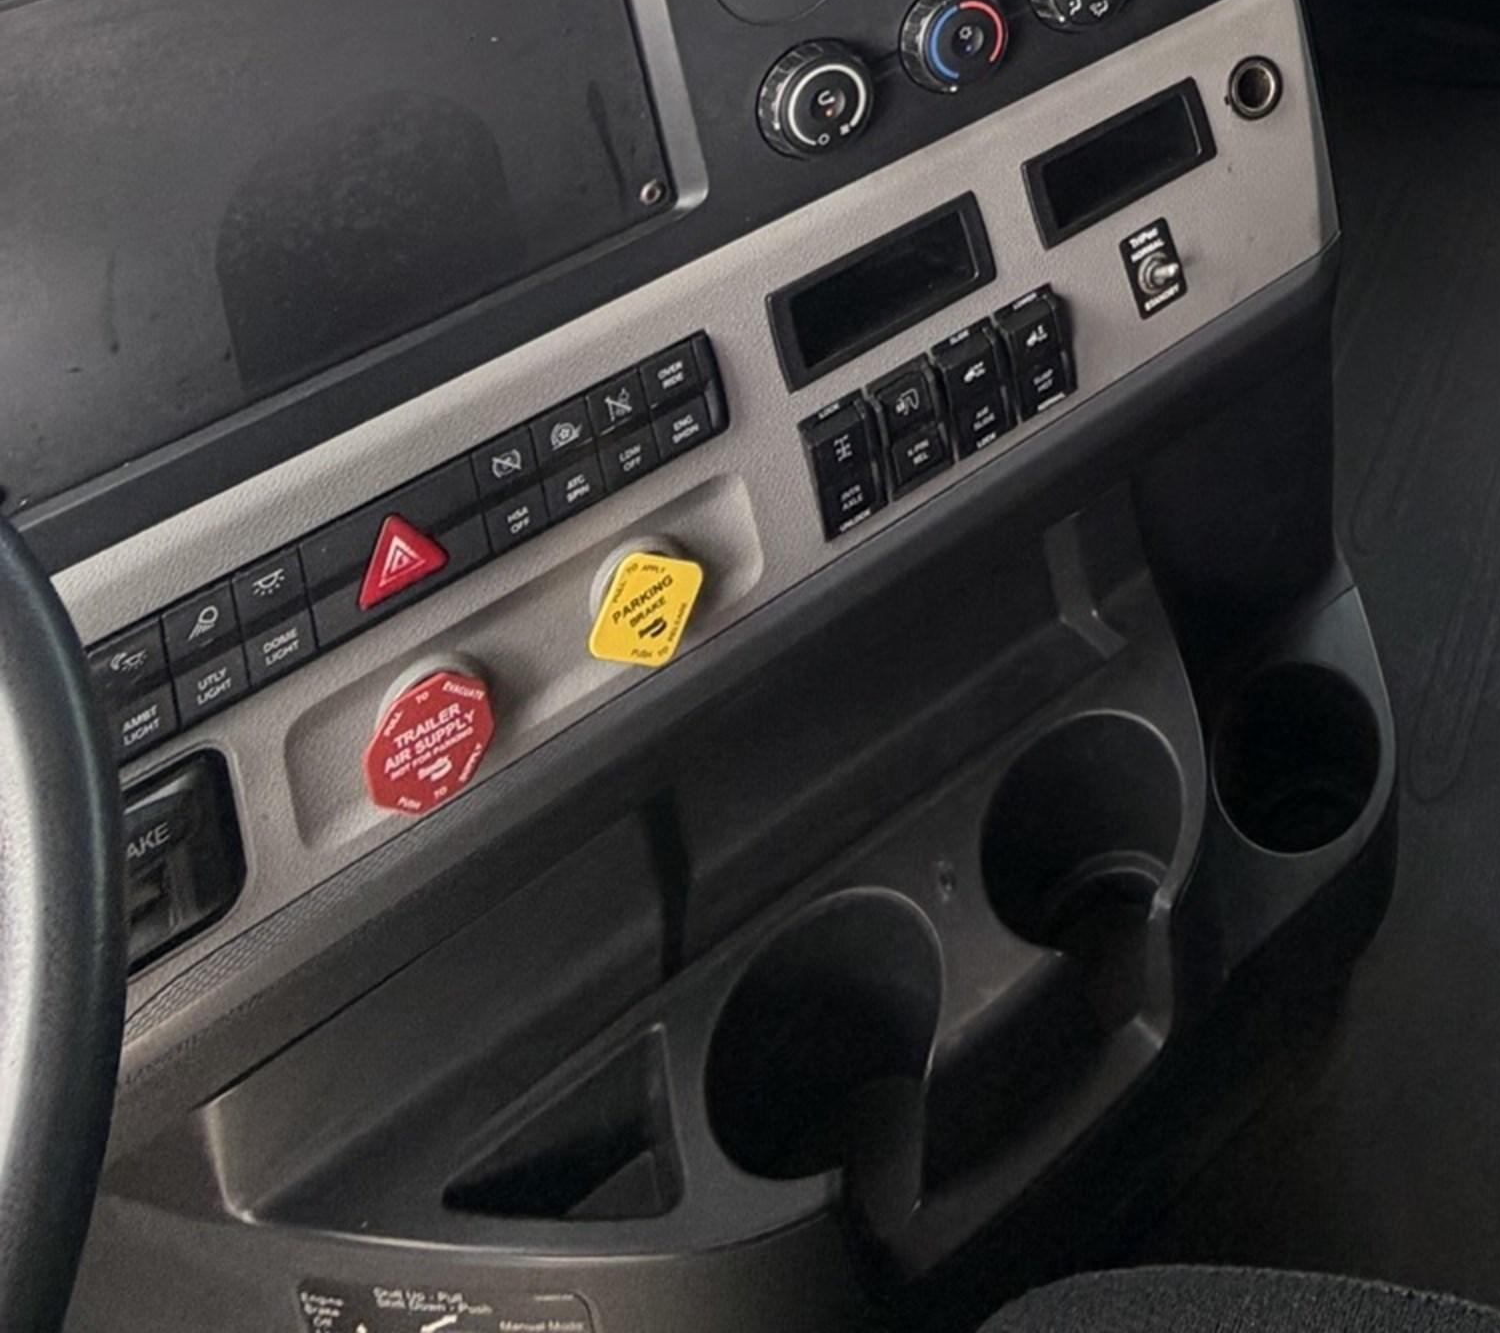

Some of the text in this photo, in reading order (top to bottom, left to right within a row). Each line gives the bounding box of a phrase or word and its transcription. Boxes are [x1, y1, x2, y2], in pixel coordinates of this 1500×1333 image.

[657, 360, 684, 380] OVER
[672, 414, 694, 432] ENG
[623, 456, 642, 472] OFF
[566, 474, 586, 491] ATC
[566, 484, 591, 503] SPIN
[510, 516, 530, 534] OFF
[611, 574, 674, 625] PARKING
[629, 596, 666, 628] BRAKE
[263, 627, 299, 654] DOME
[264, 639, 300, 666] LIGHT
[196, 678, 232, 705] LIGHT
[197, 667, 228, 691] UTLY
[416, 691, 431, 704] TO
[442, 681, 486, 701] EVACUATE
[123, 717, 160, 746] LIGHT
[393, 703, 461, 749] TRAILER
[384, 709, 476, 775] AIR SUPPLY
[412, 752, 432, 768] FOR
[433, 726, 474, 755] PARKING
[434, 786, 448, 799] TO
[125, 821, 171, 862] AKE
